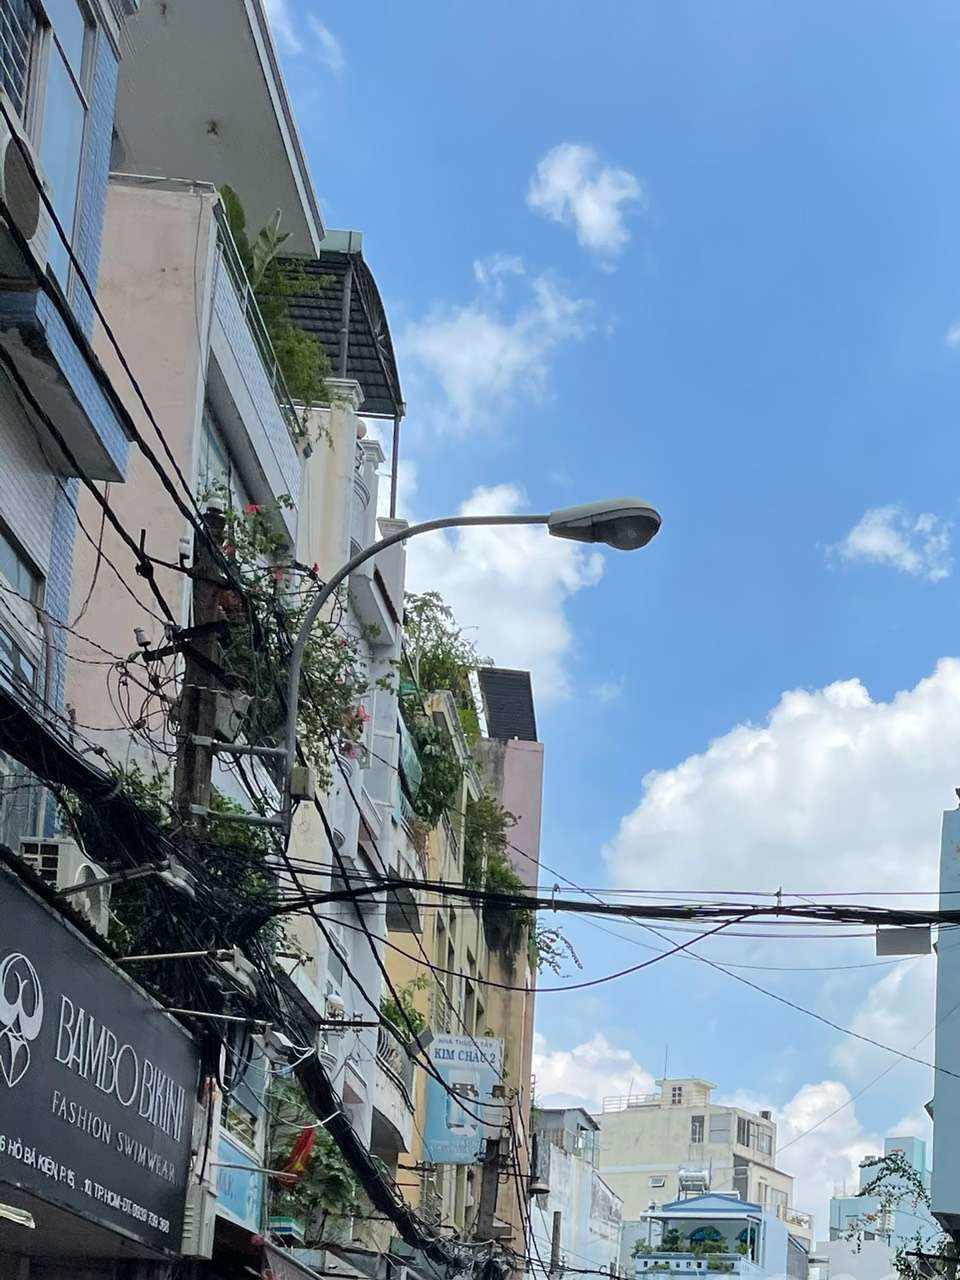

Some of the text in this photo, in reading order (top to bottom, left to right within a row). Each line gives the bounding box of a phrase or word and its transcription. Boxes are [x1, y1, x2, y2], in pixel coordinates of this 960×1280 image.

[55, 994, 186, 1143] BAMBO BIKINI
[434, 1047, 497, 1064] KIM CHÂU 2
[24, 1147, 37, 1170] BÁ
[52, 1090, 177, 1186] FASHION SWIMWEAR
